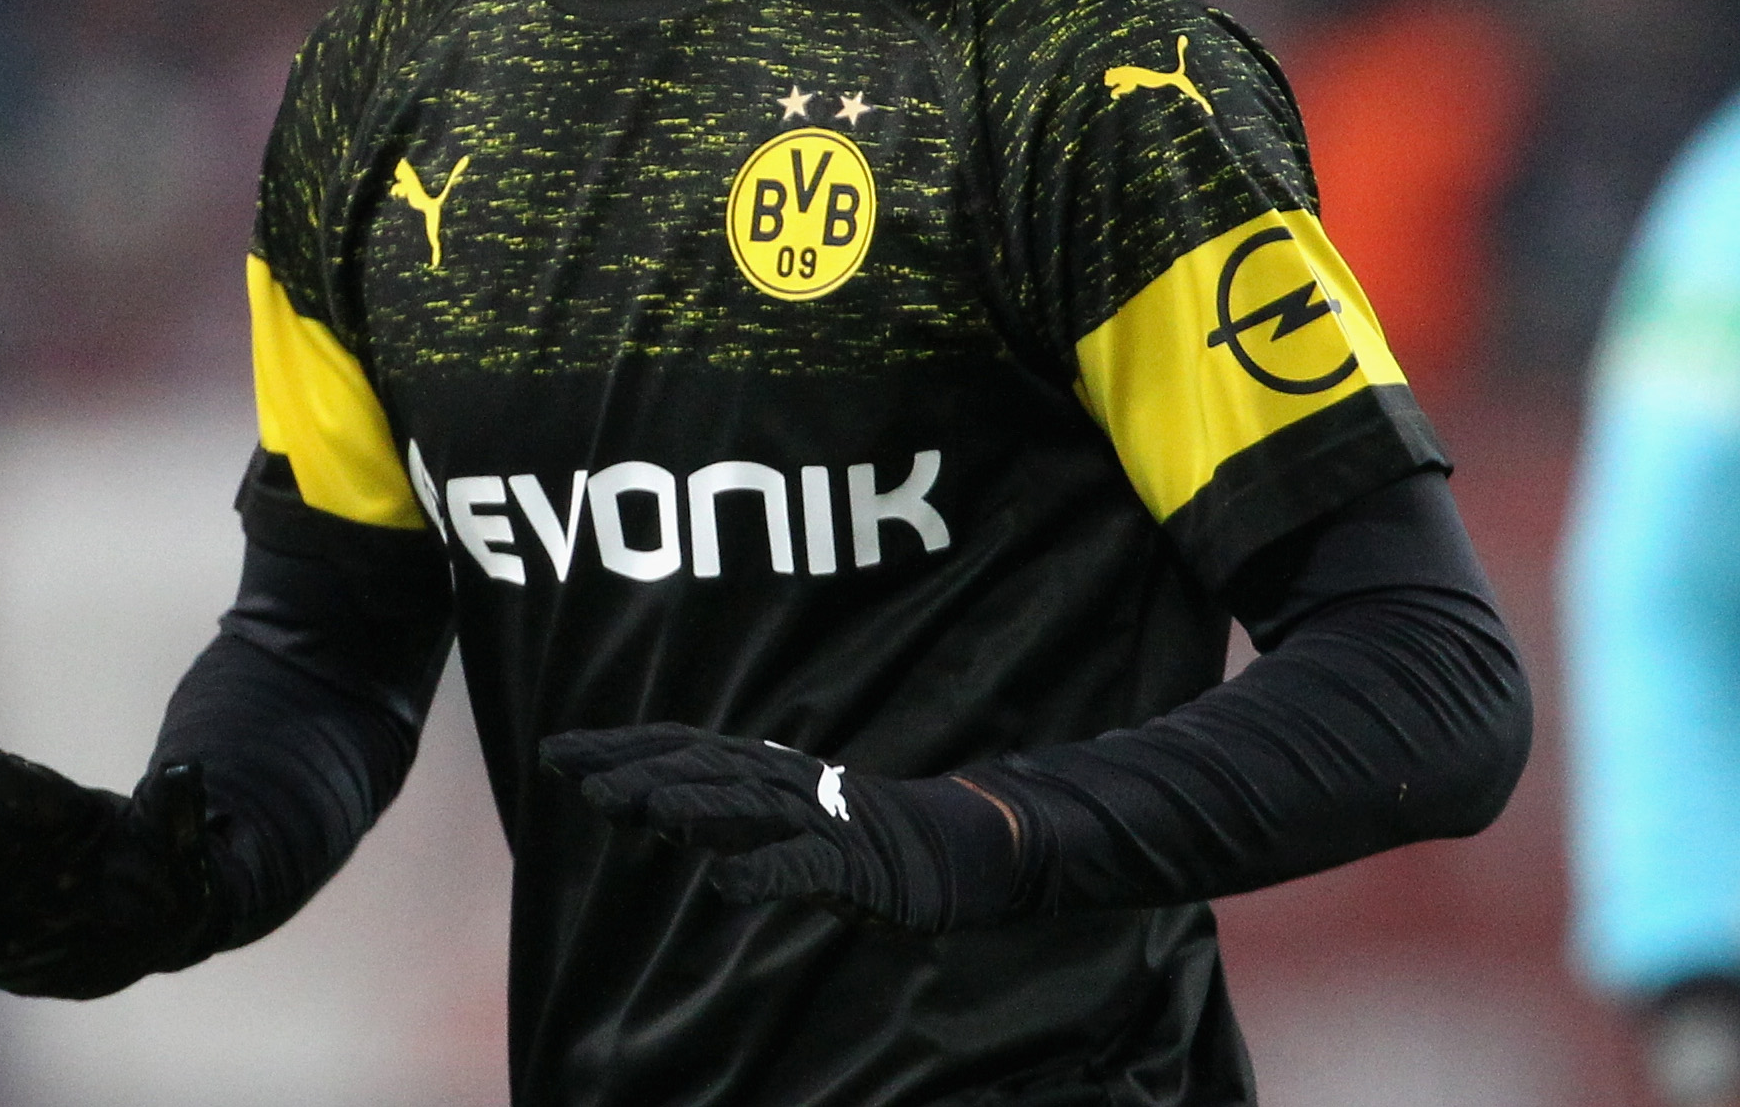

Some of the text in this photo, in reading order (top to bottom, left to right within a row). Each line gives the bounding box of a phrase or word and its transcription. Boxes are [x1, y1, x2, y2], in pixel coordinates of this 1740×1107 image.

[749, 148, 861, 247] BVB
[776, 245, 817, 280] 09
[447, 449, 951, 585] EVONIK
